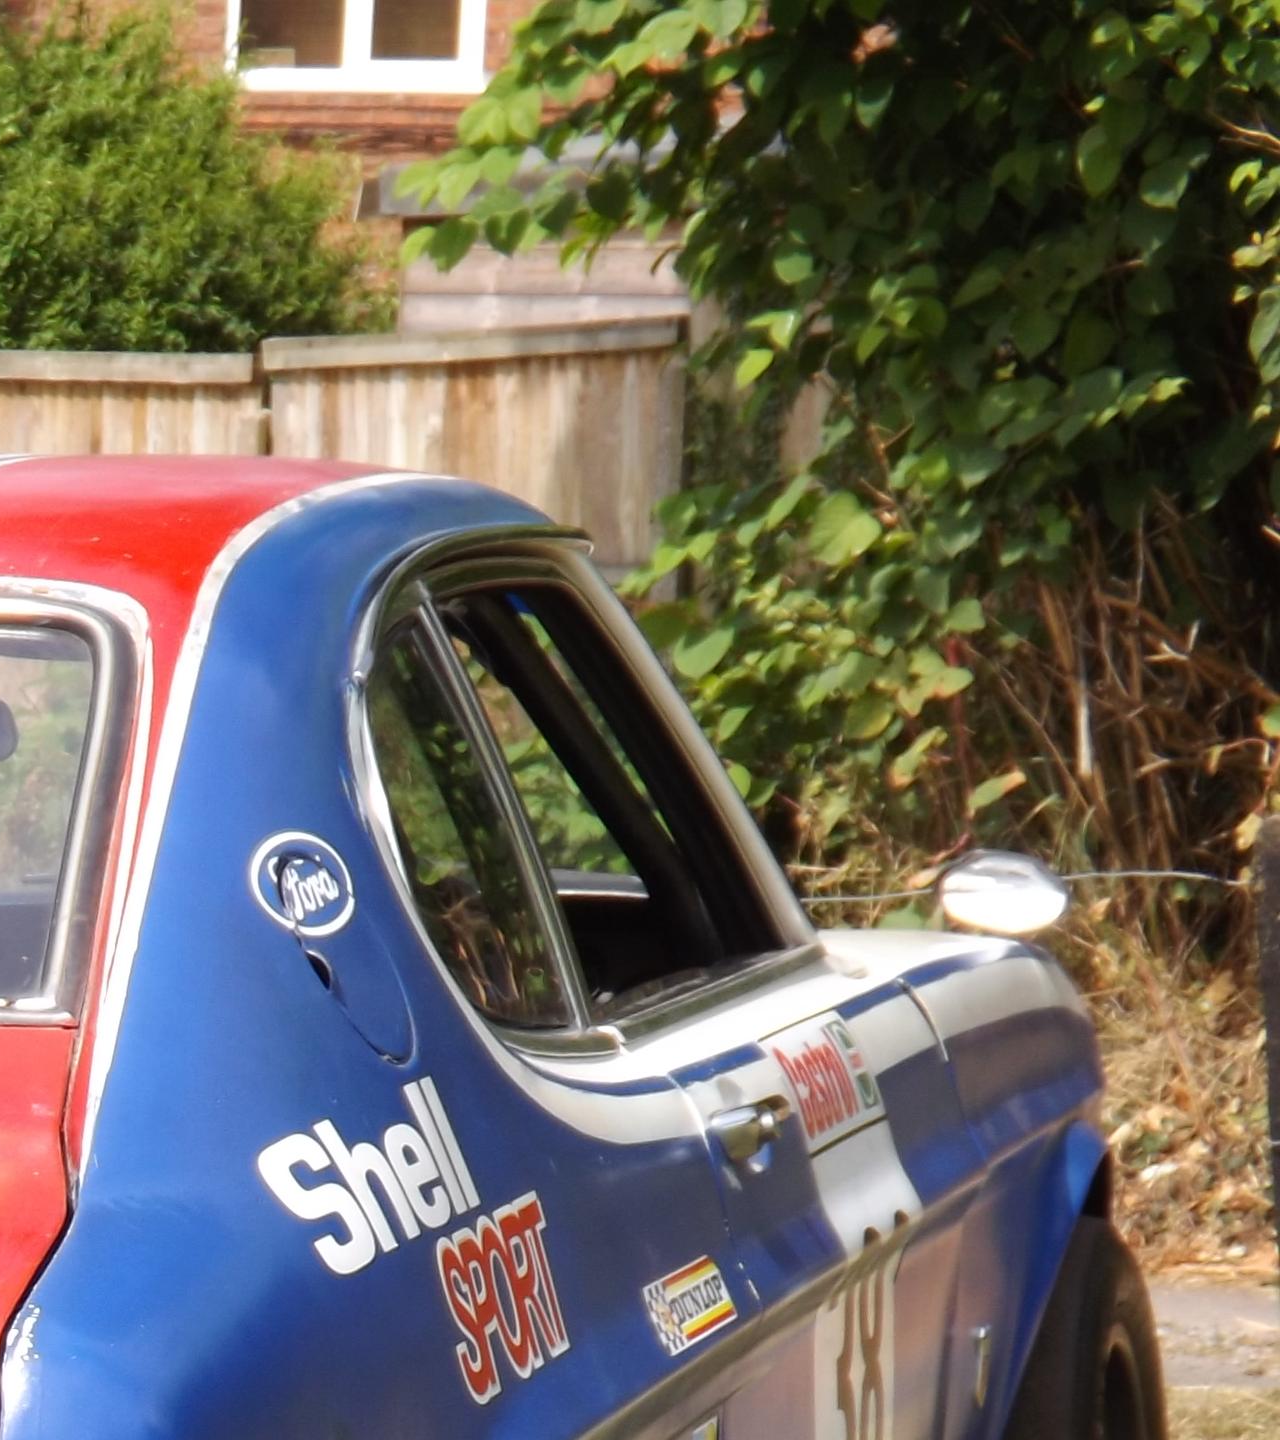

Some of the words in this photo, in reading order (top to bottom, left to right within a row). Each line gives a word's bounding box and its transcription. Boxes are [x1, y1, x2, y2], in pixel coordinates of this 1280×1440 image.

[771, 1026, 860, 1140] Castrol
[256, 1075, 481, 1275] Shell
[434, 1190, 570, 1405] SPORT
[669, 1272, 724, 1325] DUNLOP
